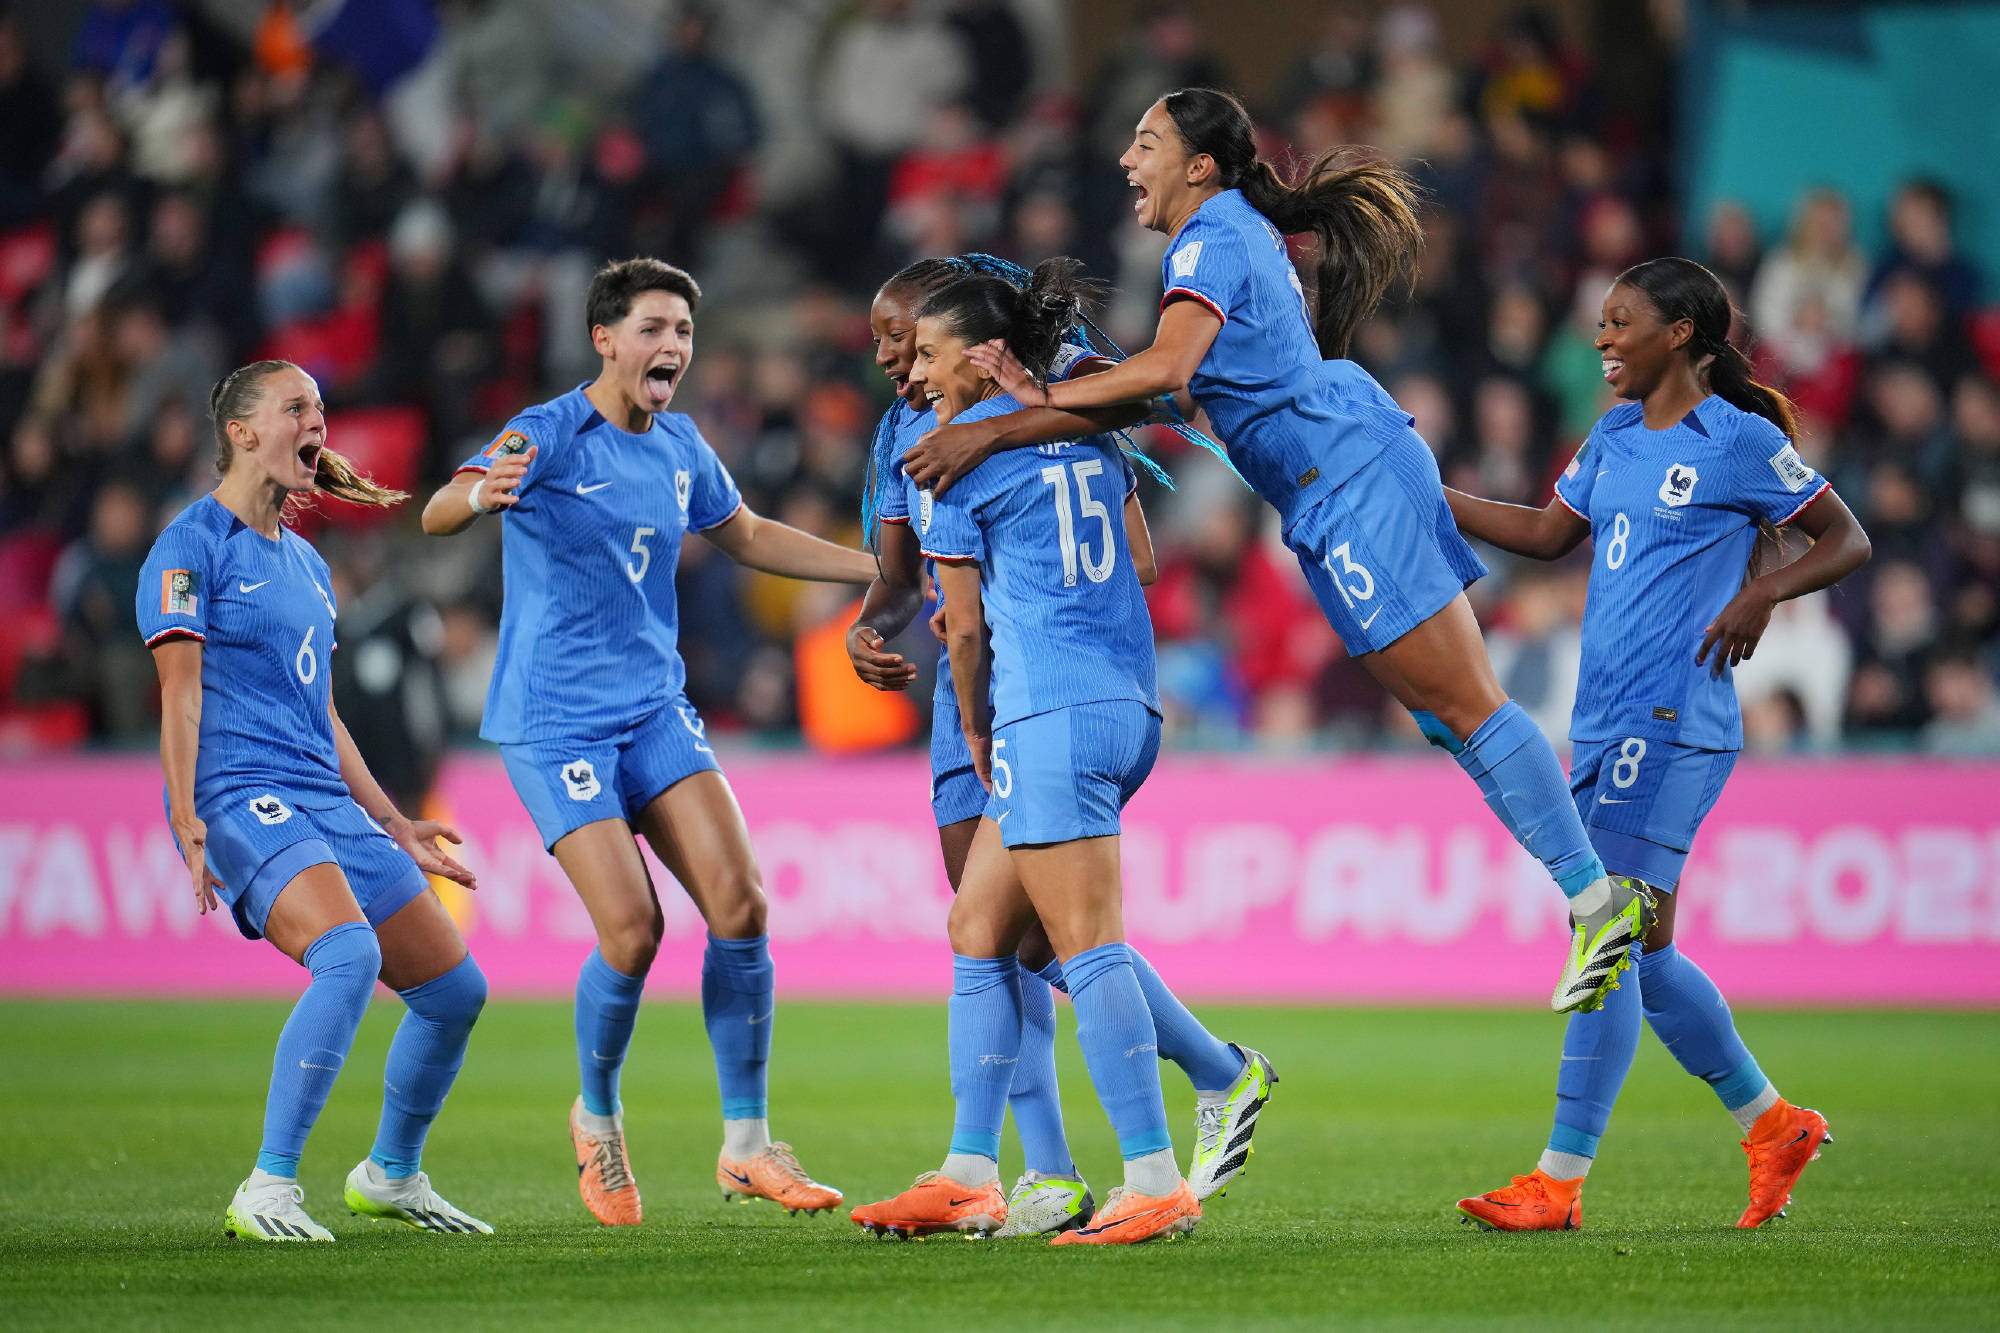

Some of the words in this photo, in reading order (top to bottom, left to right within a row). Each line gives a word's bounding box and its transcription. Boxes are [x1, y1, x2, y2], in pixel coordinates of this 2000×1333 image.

[1041, 459, 1116, 587] 15
[1606, 512, 1630, 571] 8
[627, 527, 656, 584] 5
[1324, 541, 1375, 609] 13
[296, 625, 317, 685] 6
[990, 738, 1013, 800] 5
[1612, 737, 1647, 789] 8
